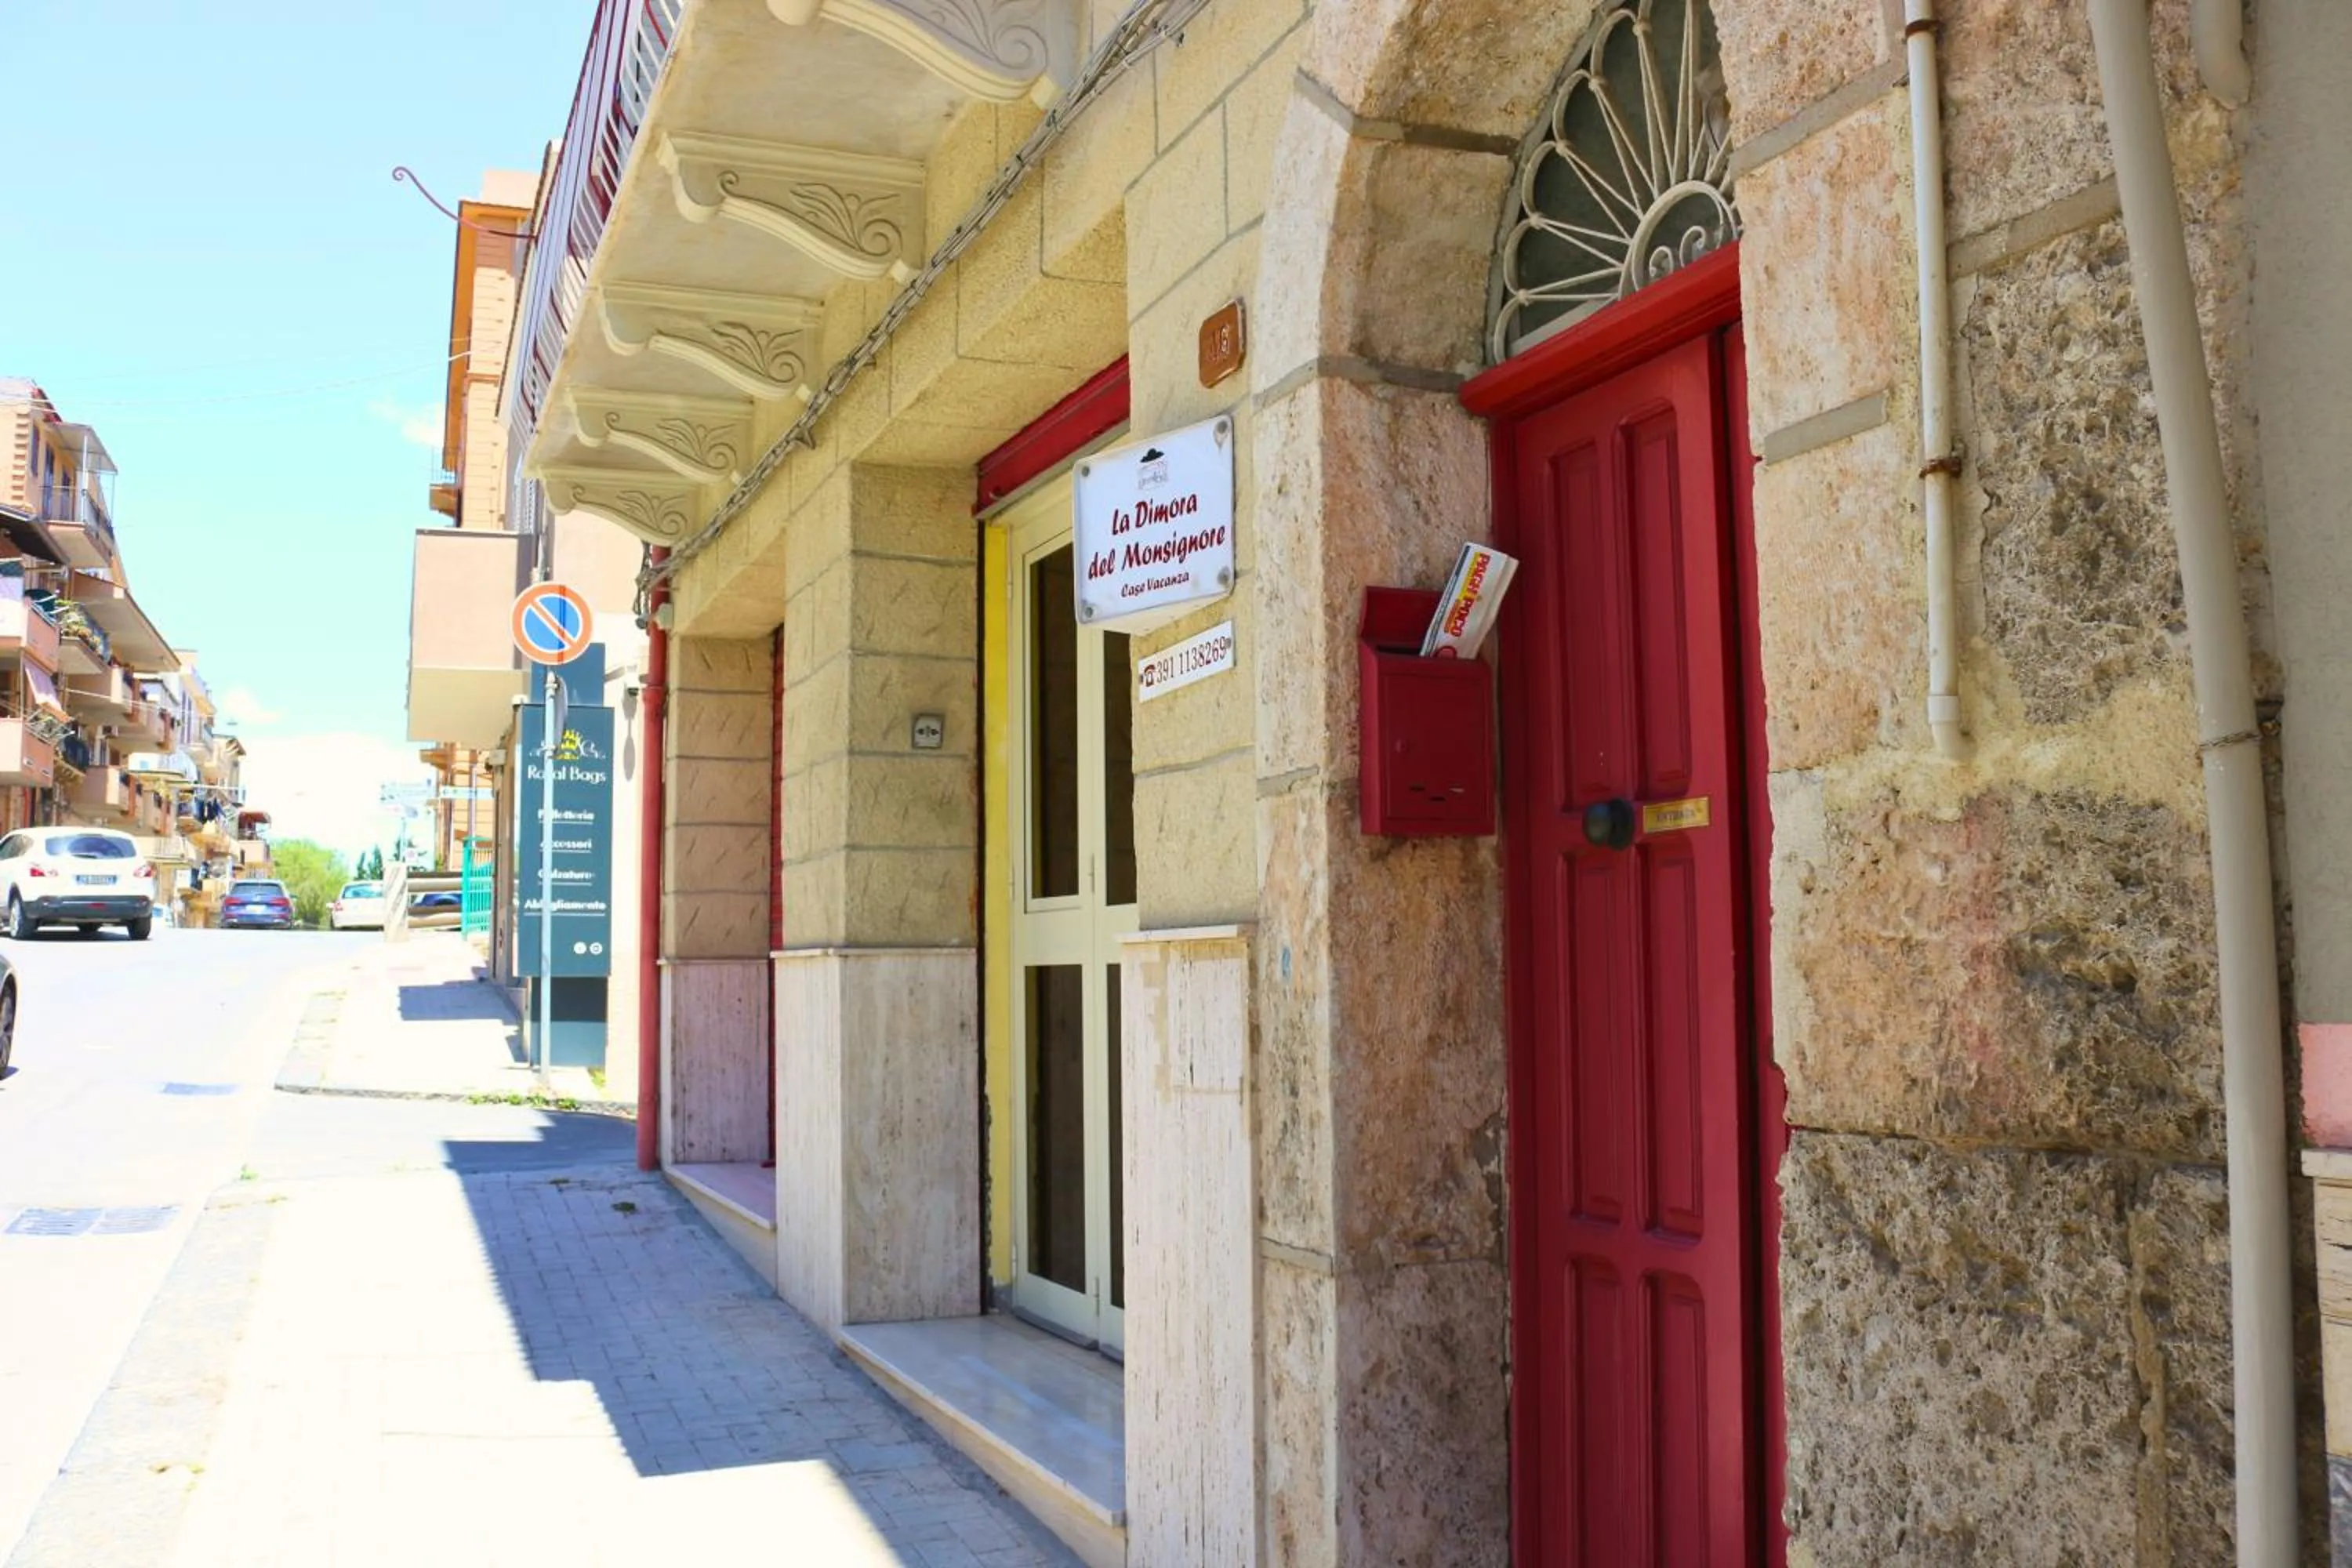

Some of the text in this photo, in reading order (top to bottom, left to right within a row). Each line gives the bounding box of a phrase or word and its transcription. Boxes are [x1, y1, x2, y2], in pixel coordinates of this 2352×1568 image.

[1135, 493, 1198, 529] Dimora
[1088, 525, 1225, 580] del Monsignore
[1147, 572, 1189, 590] Vacanza
[1156, 636, 1227, 684] 391 1138269
[528, 764, 607, 785] Roal Bags
